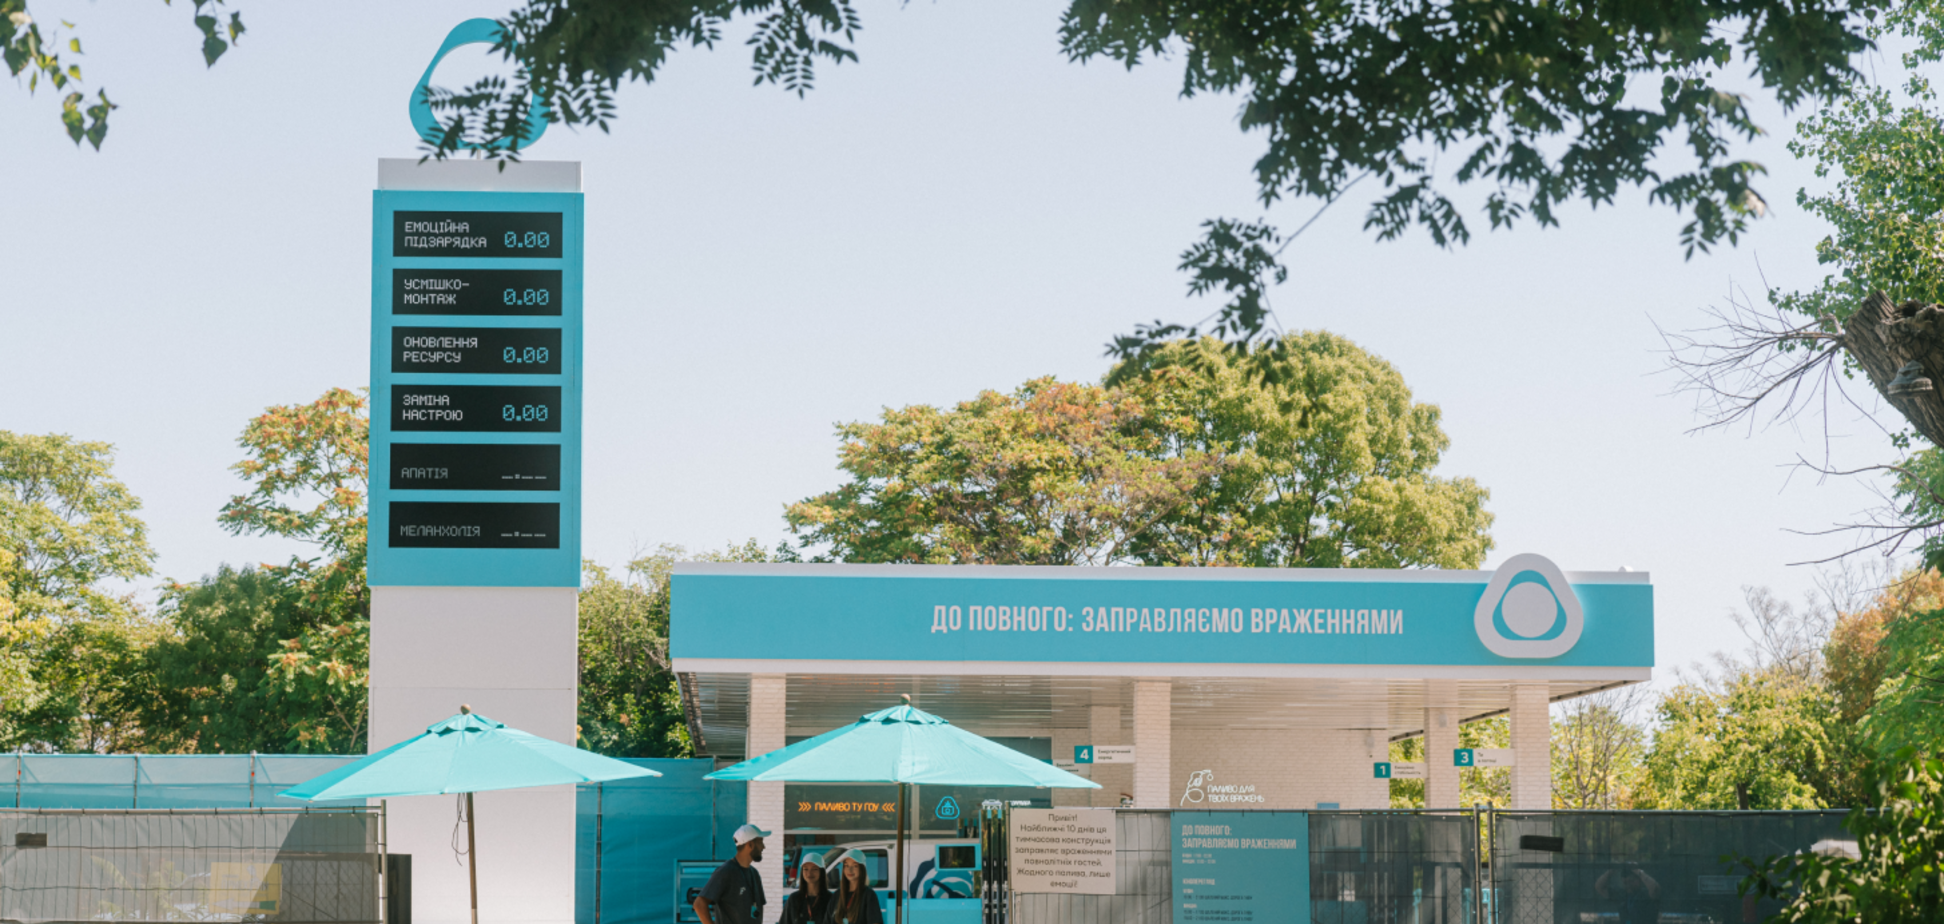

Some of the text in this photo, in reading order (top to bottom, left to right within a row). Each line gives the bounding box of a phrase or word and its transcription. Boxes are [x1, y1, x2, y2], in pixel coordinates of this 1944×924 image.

[405, 219, 469, 233] ЕМОЦІЙНА
[405, 237, 487, 248] ПІДЗАРЯДКА
[505, 232, 549, 248] 0.00
[404, 279, 469, 290] УСМІШКО-
[404, 294, 456, 304] МОНТАЖ
[504, 289, 549, 305] 0.00
[404, 337, 477, 348] ОНОВЛЕННЯ
[403, 352, 461, 362] РЕСУРСУ
[503, 347, 548, 363] 0.00
[403, 395, 449, 406] ЗАМІНА
[403, 410, 463, 420] НАСТРОЮ
[503, 405, 548, 421] 0.00
[401, 468, 448, 479] АПАТІЯ
[400, 526, 480, 536] МЕЛАНХОЛІЯ
[931, 605, 1403, 634] ДО ПОВНОГО: ЗАПРАВЛЯЄМО ВРАЖЕННЯМИ
[1080, 749, 1089, 760] 4
[1461, 752, 1468, 763] 3
[1380, 766, 1385, 775] 1
[1239, 785, 1255, 793] ДЛЯ
[815, 802, 879, 812] ПАЛИВО ТУ ГОУ
[1048, 814, 1077, 822] Привіт!
[1077, 826, 1095, 834] днів
[1182, 825, 1232, 836] ДО ПОВНОГО:
[1062, 837, 1111, 846] конструкція
[1182, 838, 1296, 849] ЗАПРАВЛЯЄМО ВРАЖЕННЯМИ
[1017, 868, 1054, 876] Жодного
